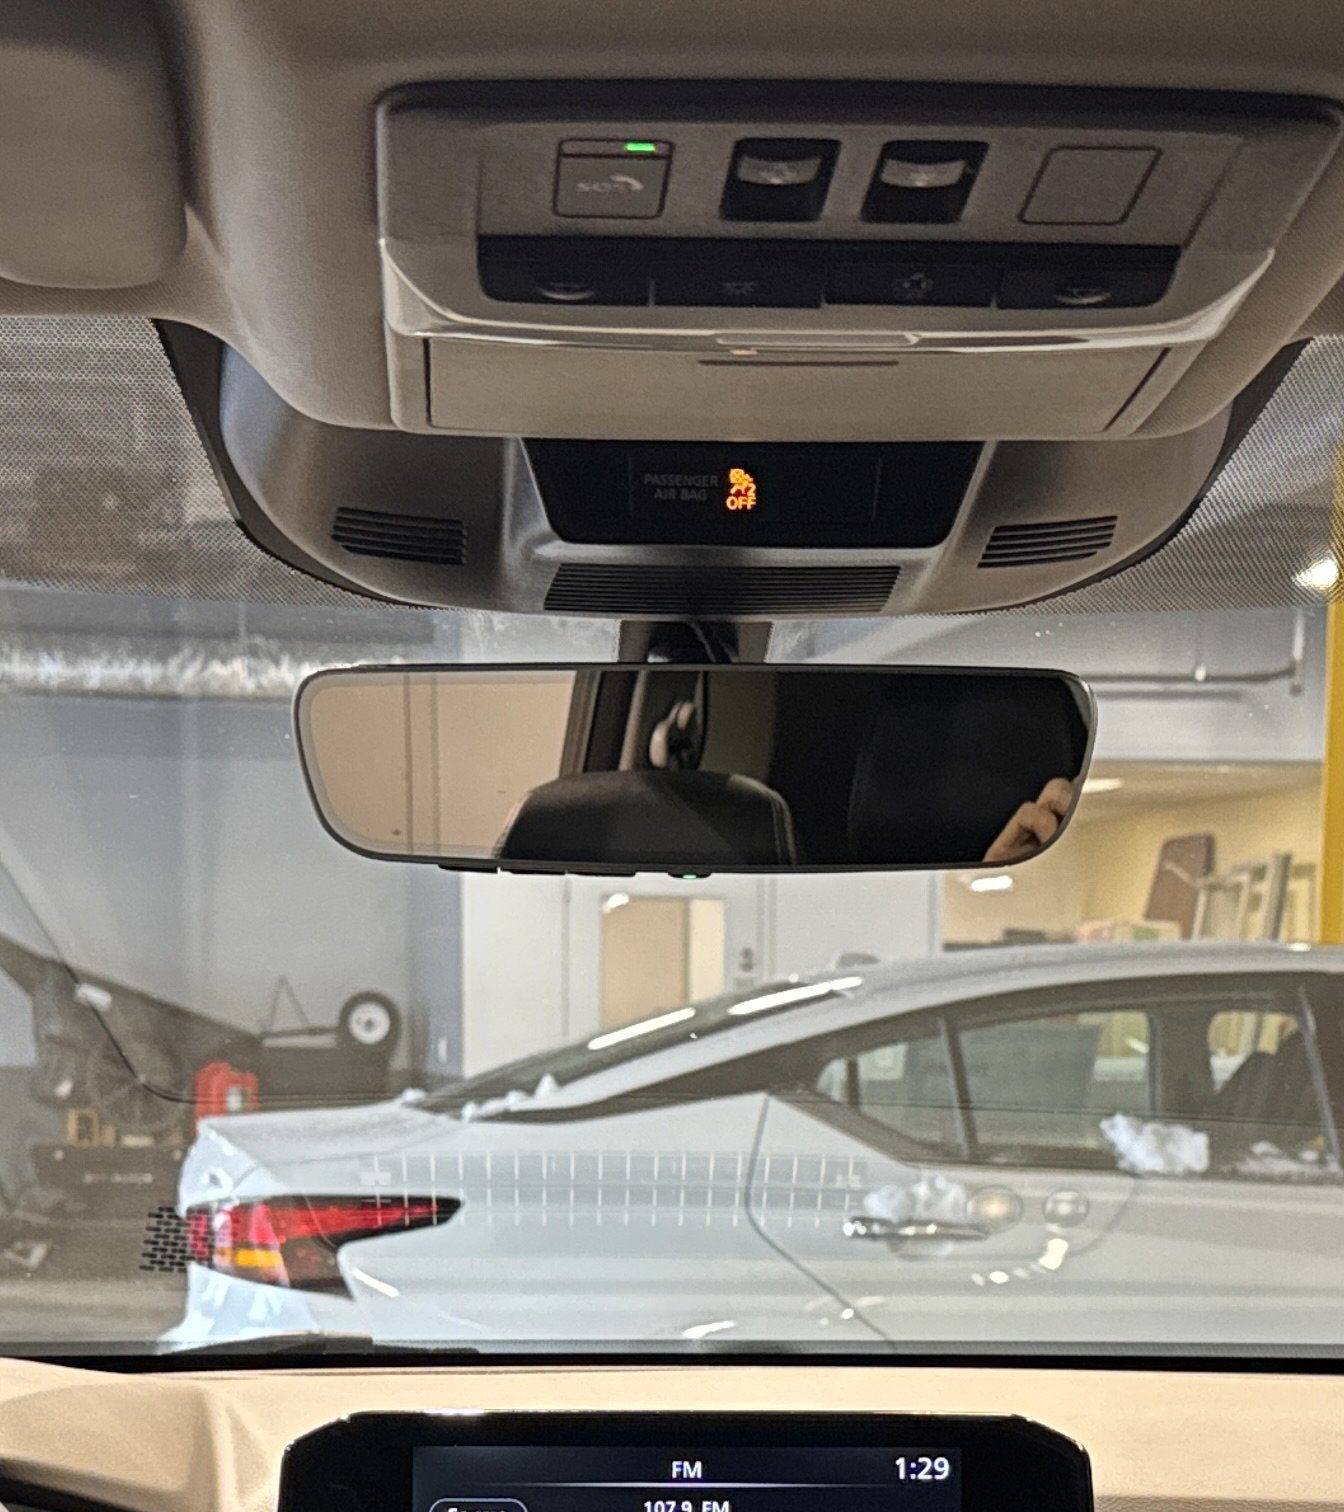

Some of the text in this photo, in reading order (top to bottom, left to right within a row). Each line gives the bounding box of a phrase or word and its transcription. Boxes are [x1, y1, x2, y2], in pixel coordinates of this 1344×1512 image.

[643, 473, 720, 487] PASSENGER
[654, 488, 708, 500] AIR BAG
[725, 495, 757, 511] OFF
[670, 1460, 703, 1479] FM
[894, 1456, 951, 1480] 1:29
